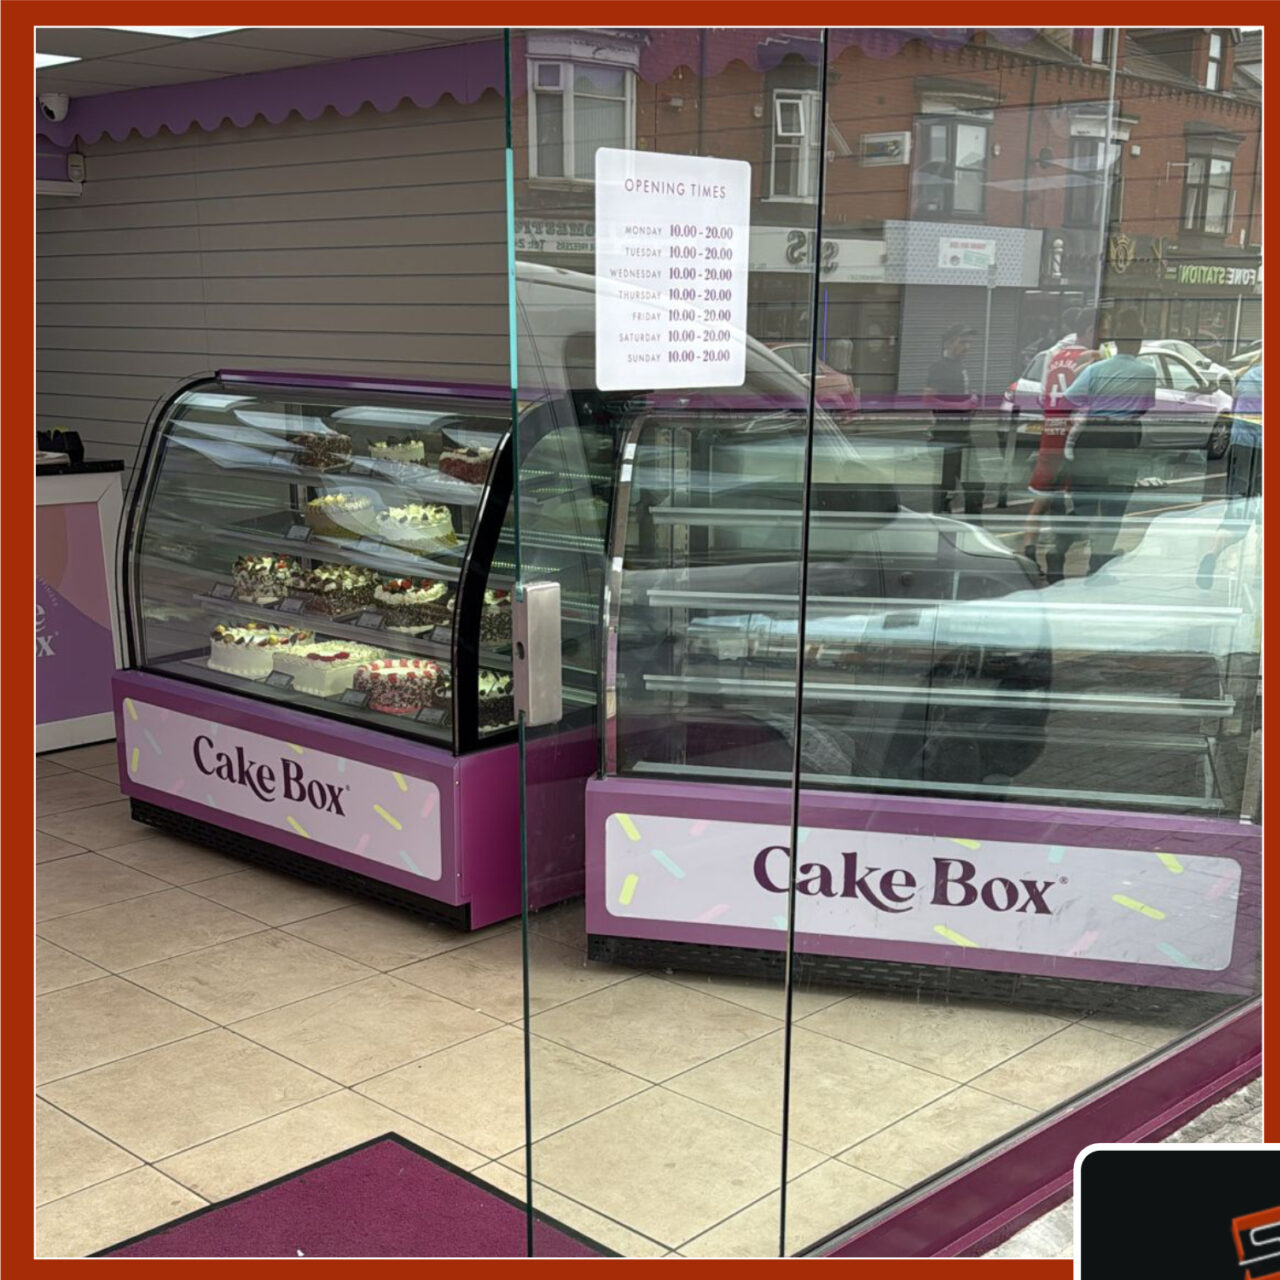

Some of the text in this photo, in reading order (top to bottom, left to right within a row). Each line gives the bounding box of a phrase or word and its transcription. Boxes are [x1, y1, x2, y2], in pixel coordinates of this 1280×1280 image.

[624, 178, 726, 199] OPENING TIMES
[624, 225, 662, 236] MONDAY
[624, 246, 662, 257] TUESDAY
[609, 268, 662, 279] WEDNESDAY
[618, 290, 661, 300] THURSDAY
[632, 311, 661, 321] FRIDAY
[618, 332, 661, 343] SATURDAY
[627, 353, 661, 363] SUNDAY
[193, 735, 346, 817] Cake Box
[753, 845, 1055, 915] Cake Box
